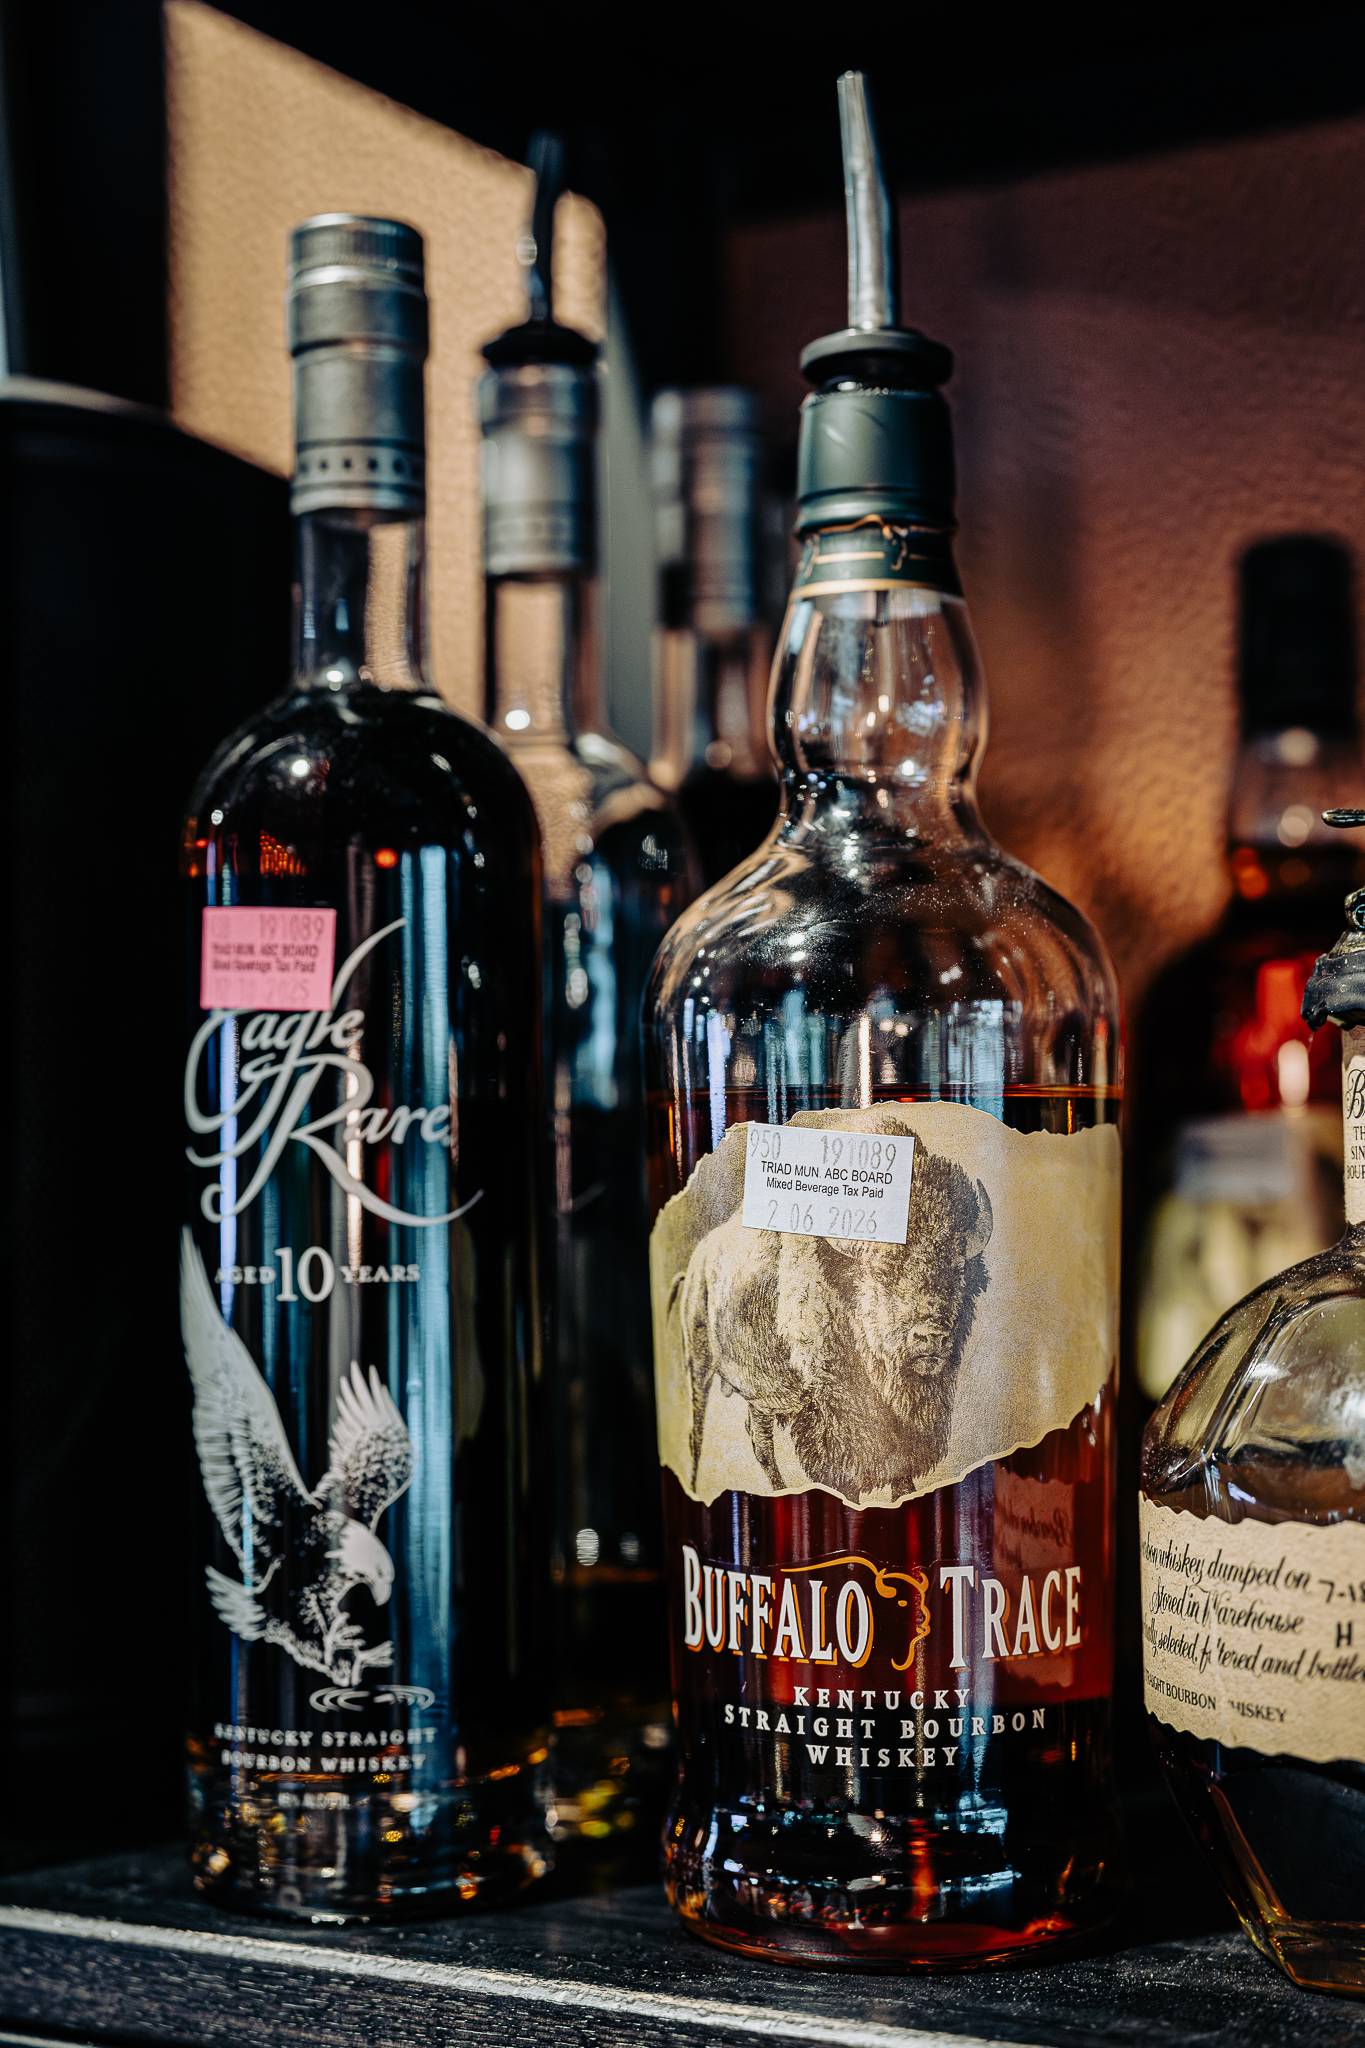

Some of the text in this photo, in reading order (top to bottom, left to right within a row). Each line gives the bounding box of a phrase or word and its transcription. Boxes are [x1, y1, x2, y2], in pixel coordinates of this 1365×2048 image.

[200, 1053, 484, 1227] Rare
[750, 1129, 897, 1171] 950 191089
[761, 1160, 893, 1185] TRIAD MUN. ABC BOARD
[766, 1176, 884, 1199] Mixed Beverage Tax Paid
[790, 1203, 813, 1232] 06
[828, 1206, 877, 1237] 2026
[215, 1246, 421, 1303] AGED 10 YEARS
[1158, 1540, 1205, 1585] whiskey
[1207, 1549, 1285, 1593] dumped
[1285, 1570, 1312, 1594] on
[682, 1545, 1082, 1671] BUFFALO TRACE
[1150, 1577, 1187, 1622] Stored
[1185, 1592, 1200, 1625] in
[1336, 1621, 1353, 1648] H
[1261, 1649, 1306, 1682] and
[793, 1686, 970, 1712] KENTUCKY
[1166, 1683, 1217, 1710] BOURBON
[321, 1727, 438, 1747] STRAIGHT
[724, 1704, 1047, 1739] STRAIGHT BOURBON
[320, 1754, 427, 1773] WHISKEY
[805, 1744, 960, 1768] WHISKEY
